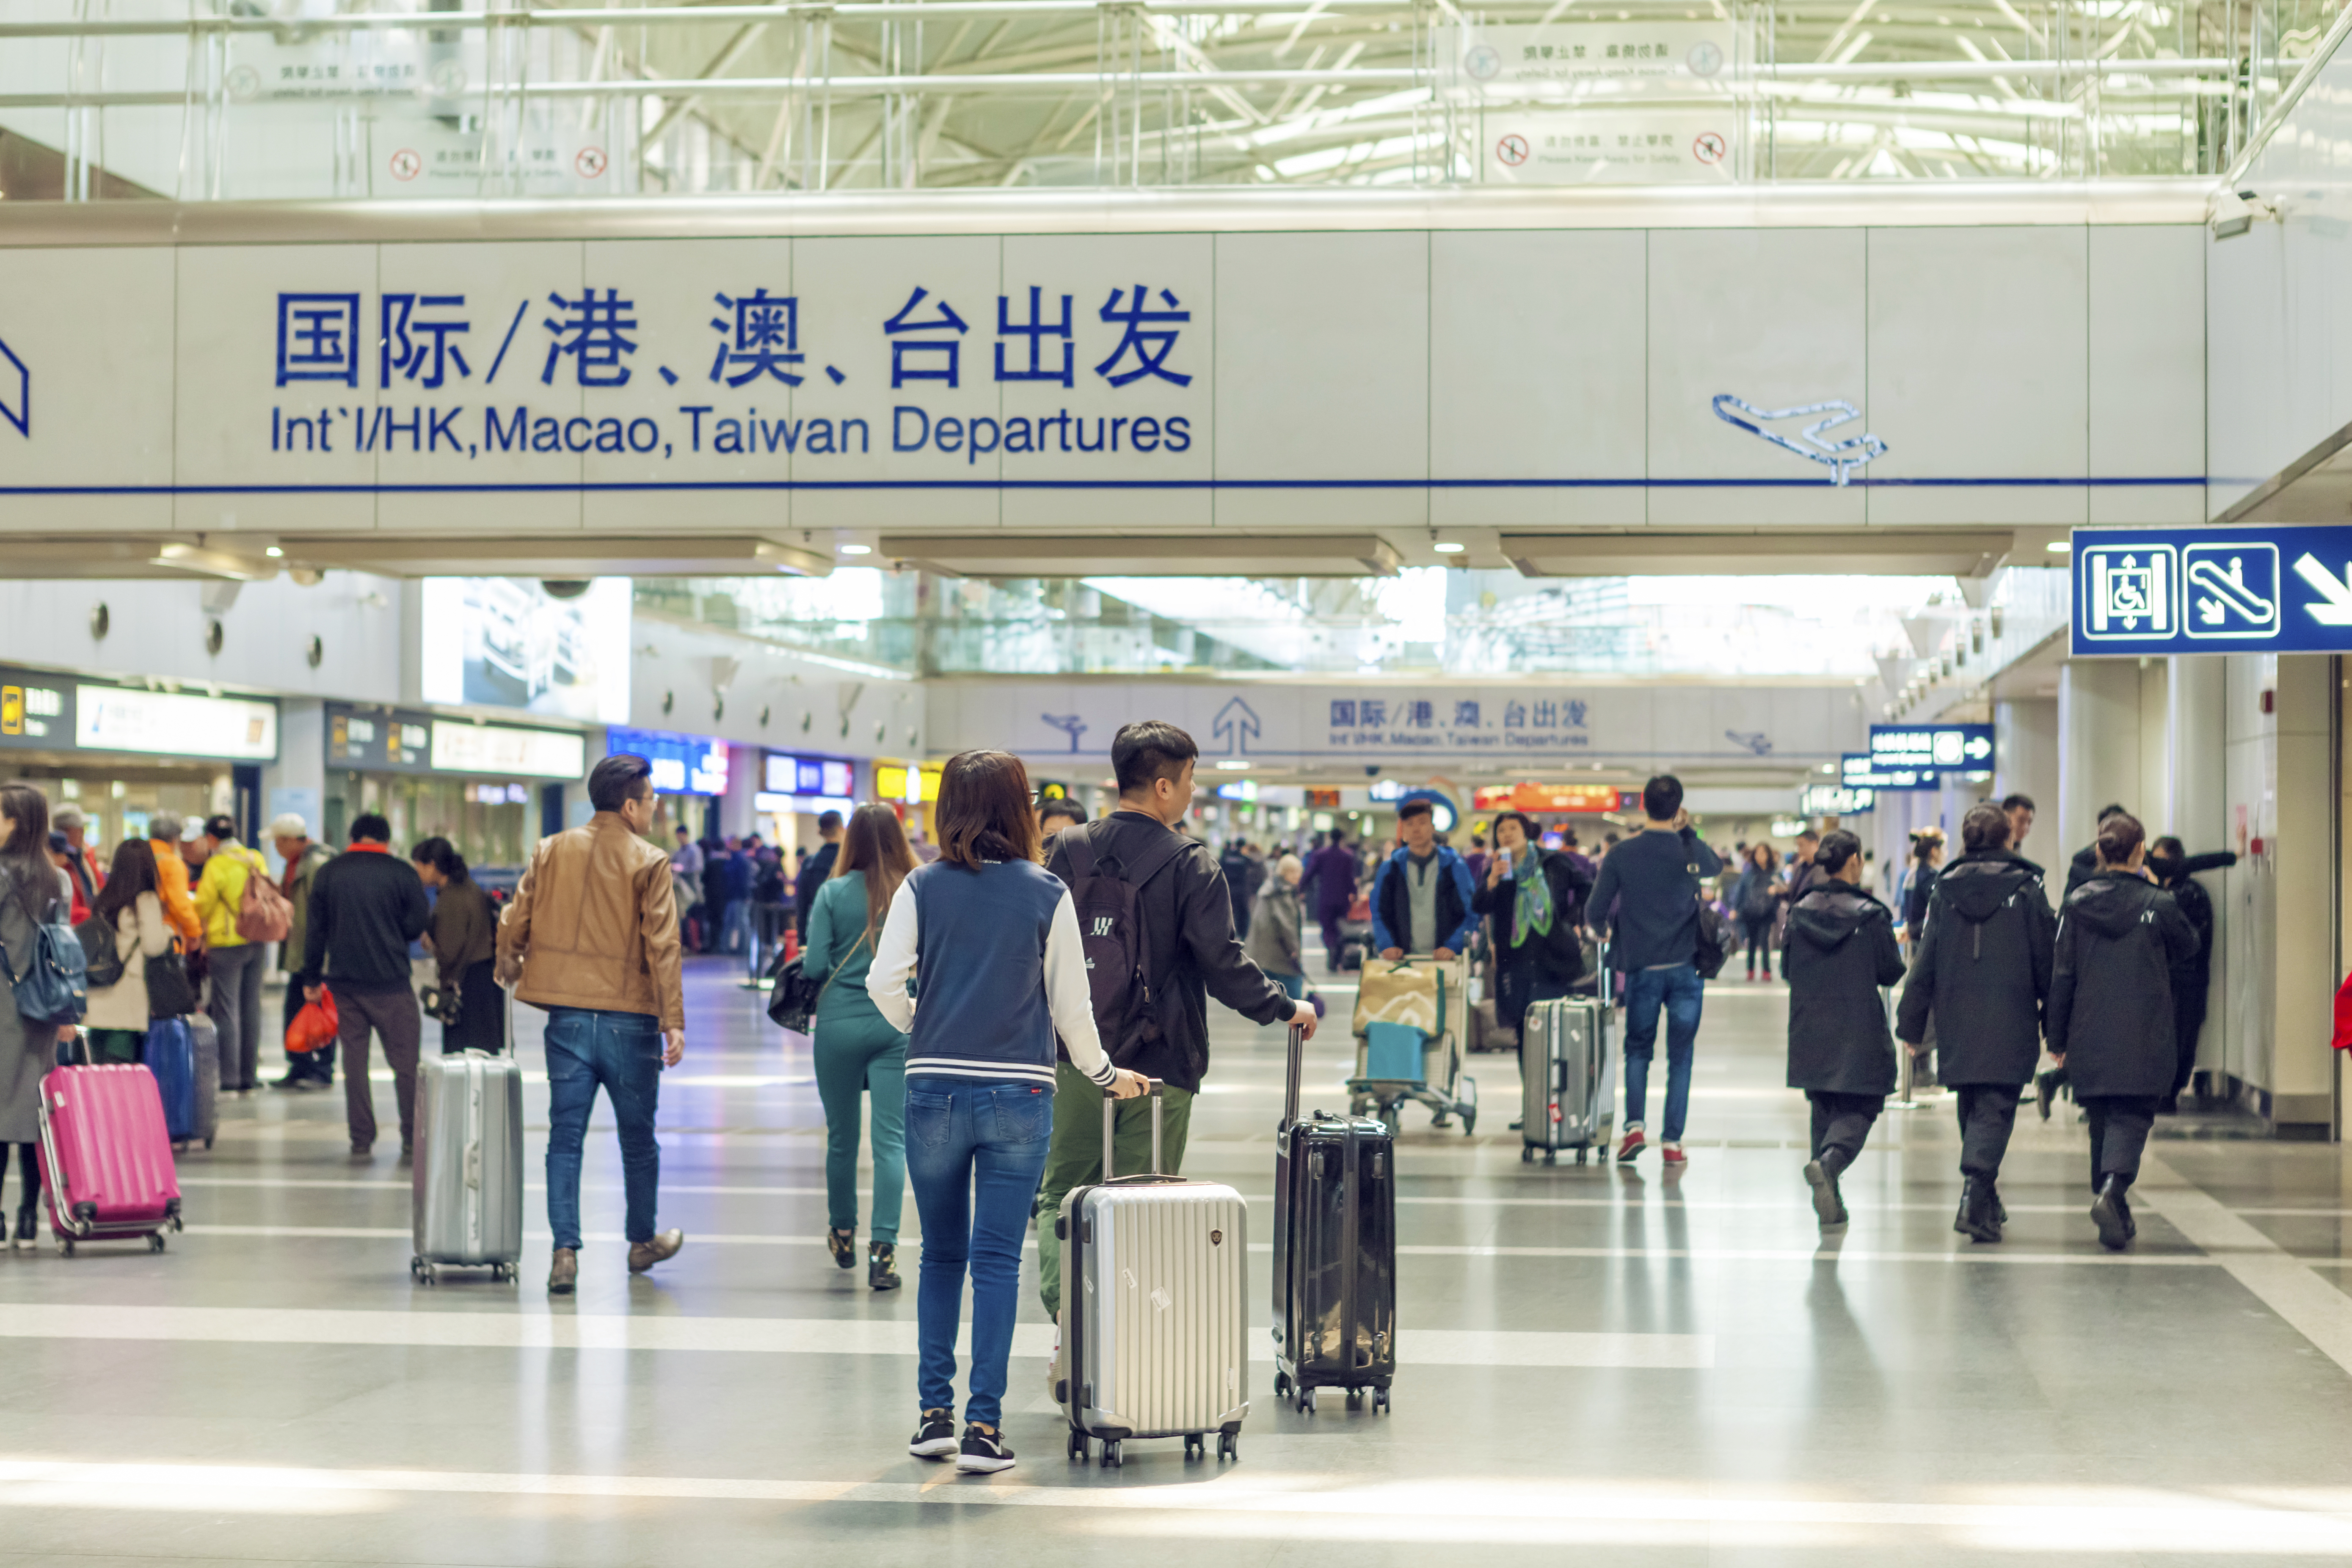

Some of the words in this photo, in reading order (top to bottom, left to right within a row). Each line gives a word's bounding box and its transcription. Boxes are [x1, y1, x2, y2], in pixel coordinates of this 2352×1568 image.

[275, 284, 1193, 389] 国际/港、澳、台出发
[893, 405, 1191, 464] Departures
